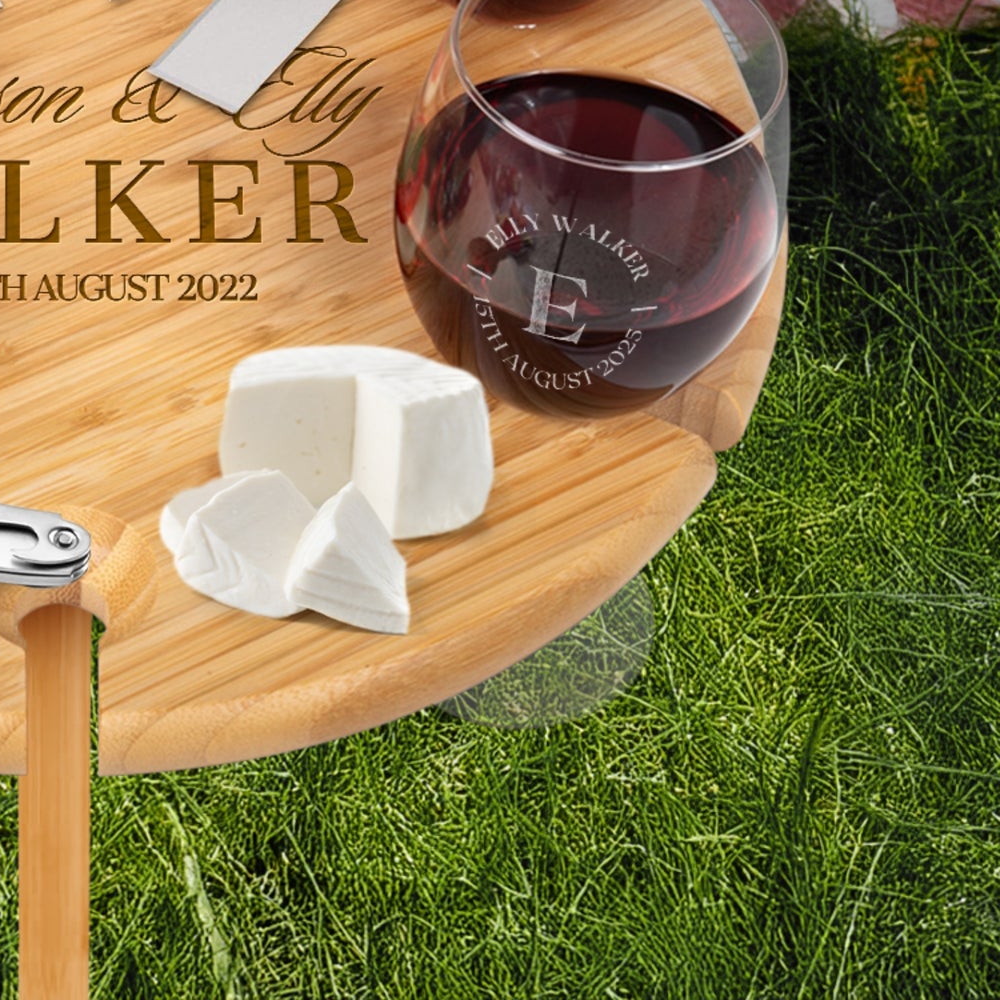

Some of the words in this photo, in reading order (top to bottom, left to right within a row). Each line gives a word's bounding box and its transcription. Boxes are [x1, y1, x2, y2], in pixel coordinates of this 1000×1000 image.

[218, 45, 384, 157] Elly
[485, 213, 541, 250] ELLY
[552, 214, 650, 282] WALKER
[34, 273, 170, 302] AUGUST
[177, 273, 259, 302] 2022
[522, 265, 588, 344] E
[473, 294, 508, 352] 15TH
[503, 354, 594, 390] AUGUST
[597, 328, 642, 376] 2025
